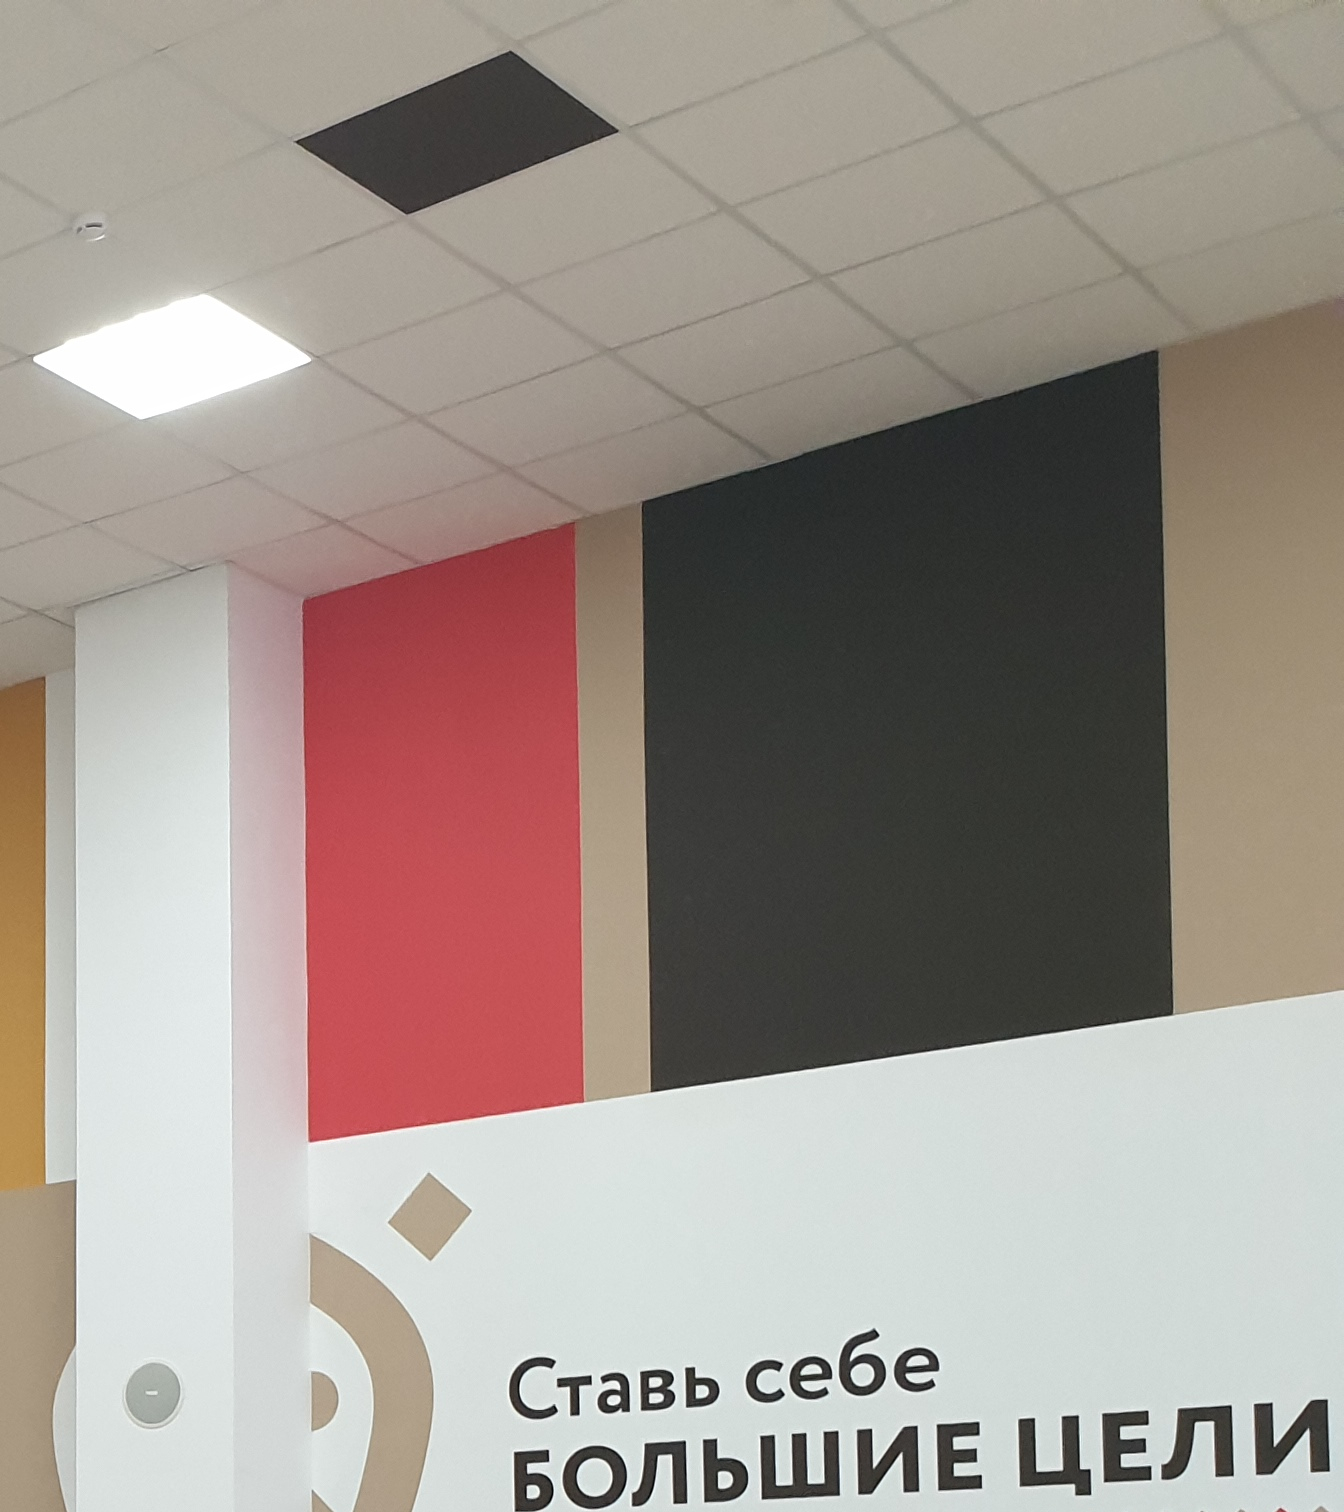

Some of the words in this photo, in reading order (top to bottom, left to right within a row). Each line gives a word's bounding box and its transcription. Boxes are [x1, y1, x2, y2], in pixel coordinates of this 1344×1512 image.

[509, 1356, 720, 1420] Ставь
[745, 1328, 940, 1403] себе
[513, 1421, 983, 1512] БОЛЬШИЕ
[1018, 1399, 1331, 1496] ЦЕЛИ
